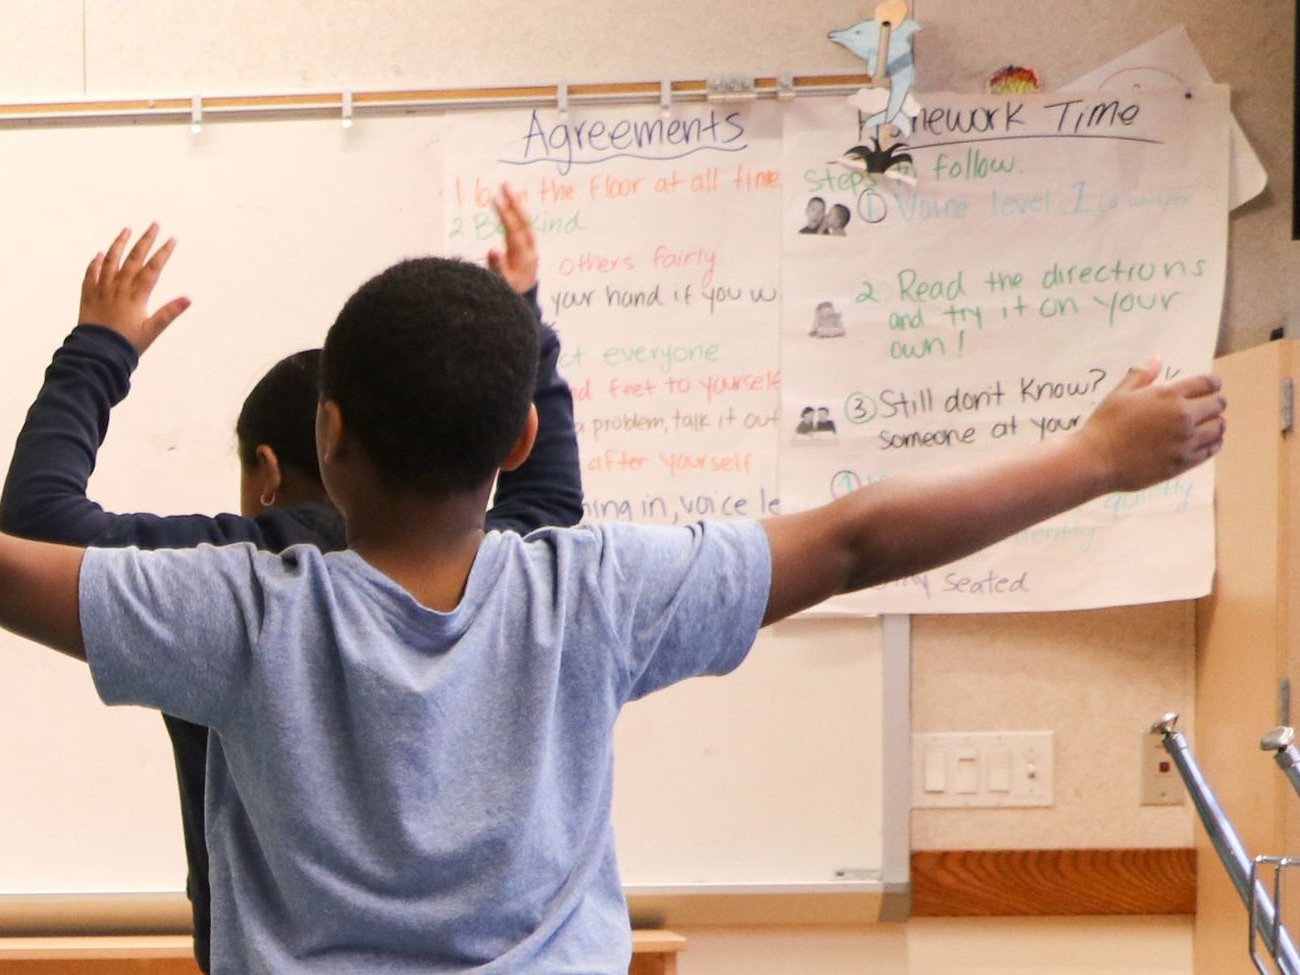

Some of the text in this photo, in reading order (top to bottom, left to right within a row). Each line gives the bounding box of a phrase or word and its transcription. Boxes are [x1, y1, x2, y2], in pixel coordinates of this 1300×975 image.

[858, 99, 1140, 141] Hmework Time
[522, 109, 745, 176] Agreements
[539, 176, 574, 203] the
[589, 174, 641, 199] floor
[654, 173, 681, 194] at
[691, 166, 722, 193] all
[653, 246, 716, 287] fairly
[897, 269, 967, 301] Read
[985, 270, 1023, 291] the
[1042, 257, 1206, 291] directions
[550, 288, 594, 318] your
[606, 284, 664, 308] hand
[673, 287, 693, 307] if
[701, 285, 742, 315] you
[888, 308, 926, 333] and
[943, 300, 982, 331] try
[1002, 299, 1030, 320] it
[1039, 298, 1079, 319] on
[602, 341, 720, 373] everyone
[889, 330, 967, 361] own!
[608, 379, 656, 399] feet
[667, 377, 693, 397] to
[879, 388, 935, 419] Still
[673, 408, 710, 431] talk
[717, 406, 736, 428] it
[742, 408, 780, 429] out
[877, 413, 1084, 450] someone at your
[586, 450, 754, 479] after yourself
[679, 489, 748, 519] voice
